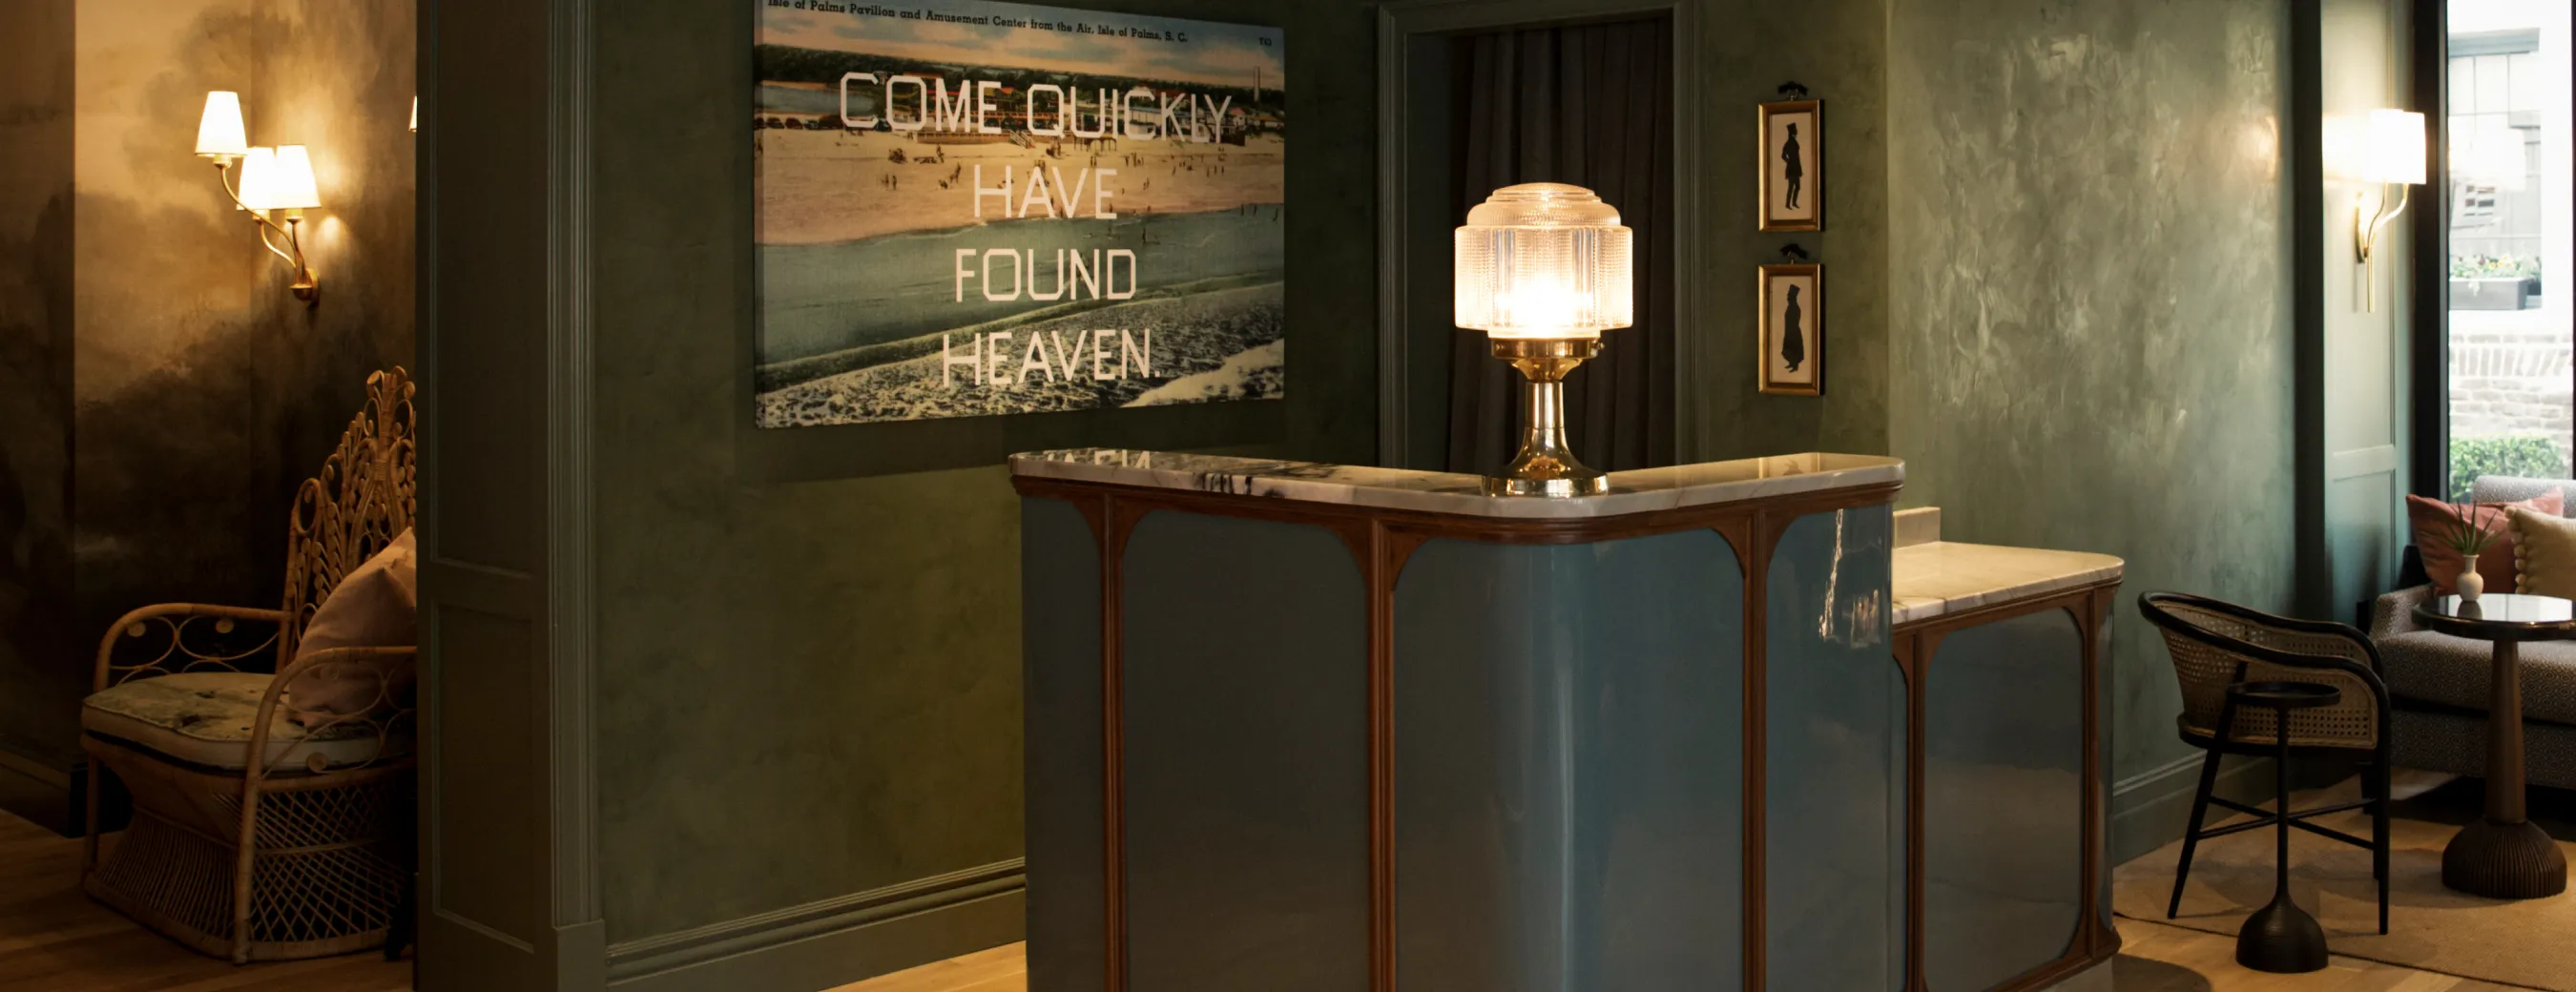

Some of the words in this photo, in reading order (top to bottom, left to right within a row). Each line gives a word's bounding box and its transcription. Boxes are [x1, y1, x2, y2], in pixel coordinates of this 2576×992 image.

[795, 0, 806, 10] of
[810, 1, 845, 13] Palms
[849, 4, 895, 17] Pavilion
[900, 10, 921, 20] and
[925, 11, 988, 25] Amusement
[992, 16, 1027, 29] Center
[1030, 19, 1053, 31] from
[1057, 22, 1072, 32] the
[1076, 23, 1094, 34] Air,
[1098, 25, 1115, 36] Isle
[1119, 27, 1128, 36] of
[1131, 28, 1162, 41] Palms,
[1165, 31, 1174, 42] S.
[1177, 32, 1188, 43] C.
[840, 72, 1002, 135] COME
[1027, 83, 1232, 144] QUICKLY
[973, 164, 1117, 219] HAVE
[956, 248, 1136, 302] FOUND
[942, 328, 1160, 386] HEAVEN.
